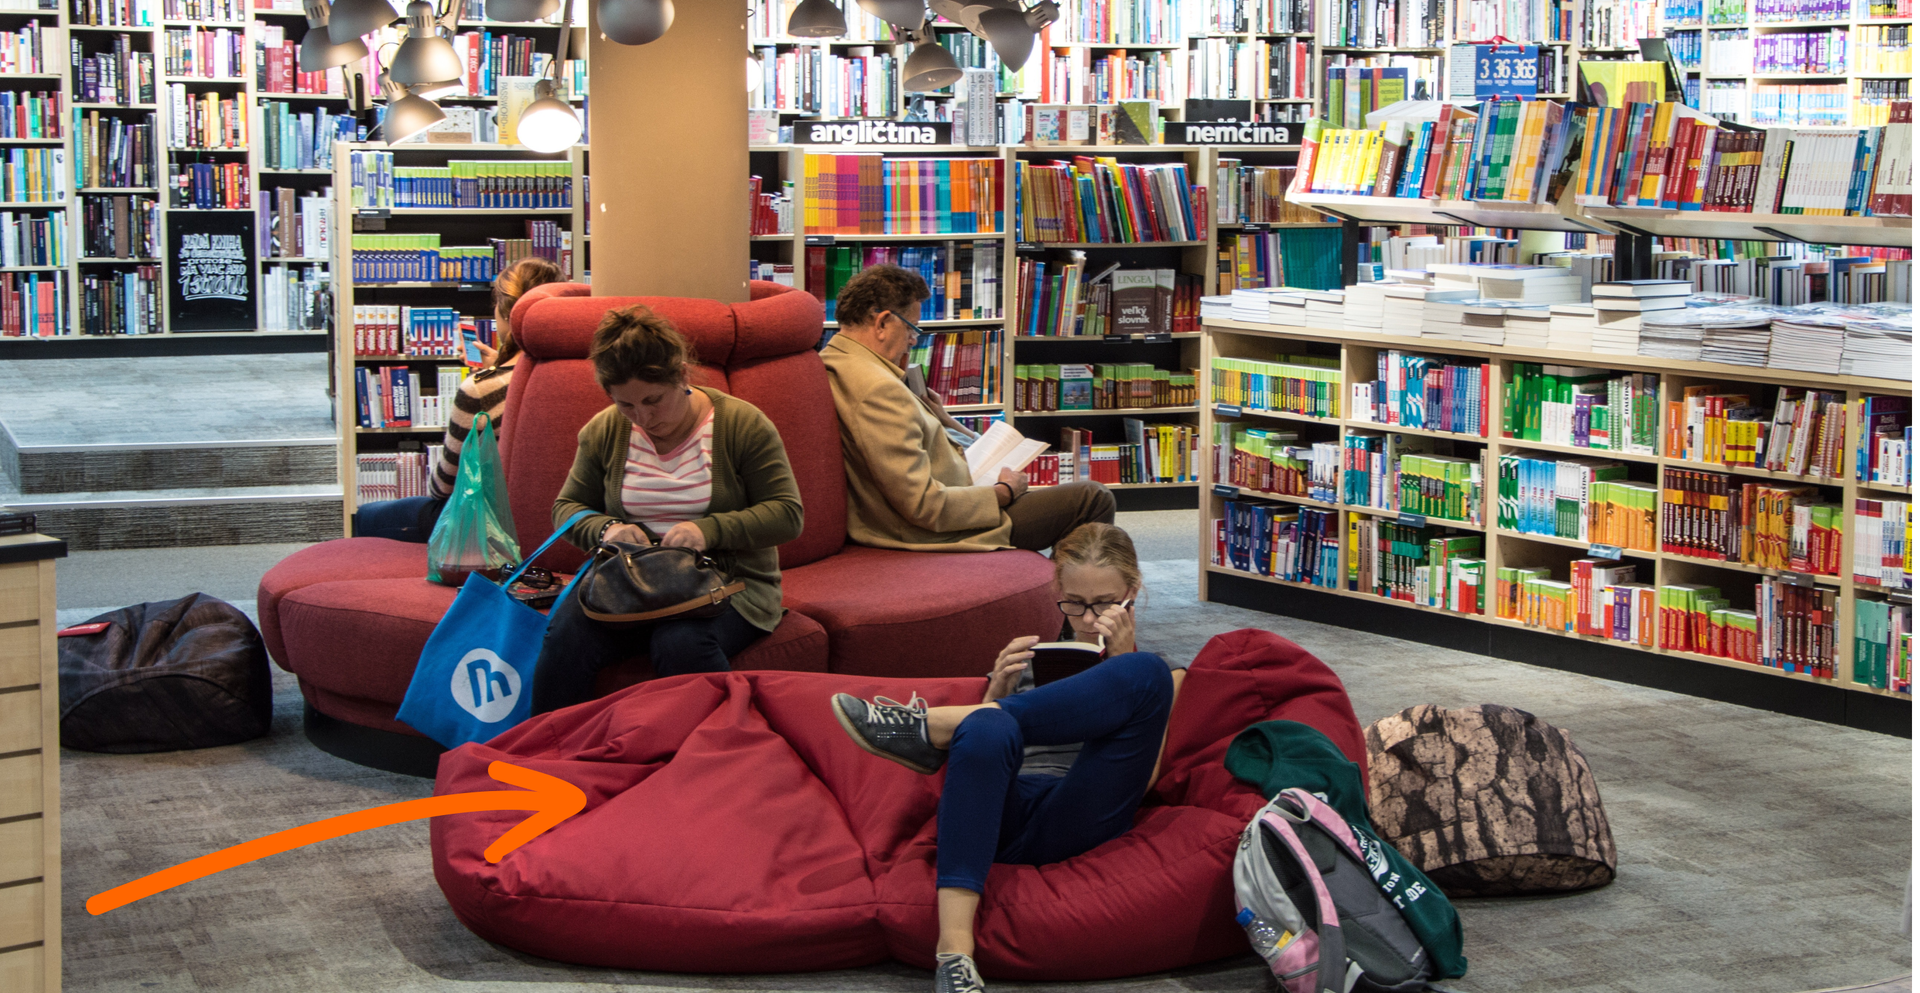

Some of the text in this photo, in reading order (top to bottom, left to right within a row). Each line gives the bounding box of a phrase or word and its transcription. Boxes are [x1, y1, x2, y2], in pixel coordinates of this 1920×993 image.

[1480, 57, 1537, 79] 3 36 365
[810, 121, 938, 145] angličtina
[1185, 122, 1290, 143] nemčina
[1117, 275, 1153, 284] LINGEA
[1118, 315, 1150, 324] slovník
[1121, 306, 1147, 318] veľký
